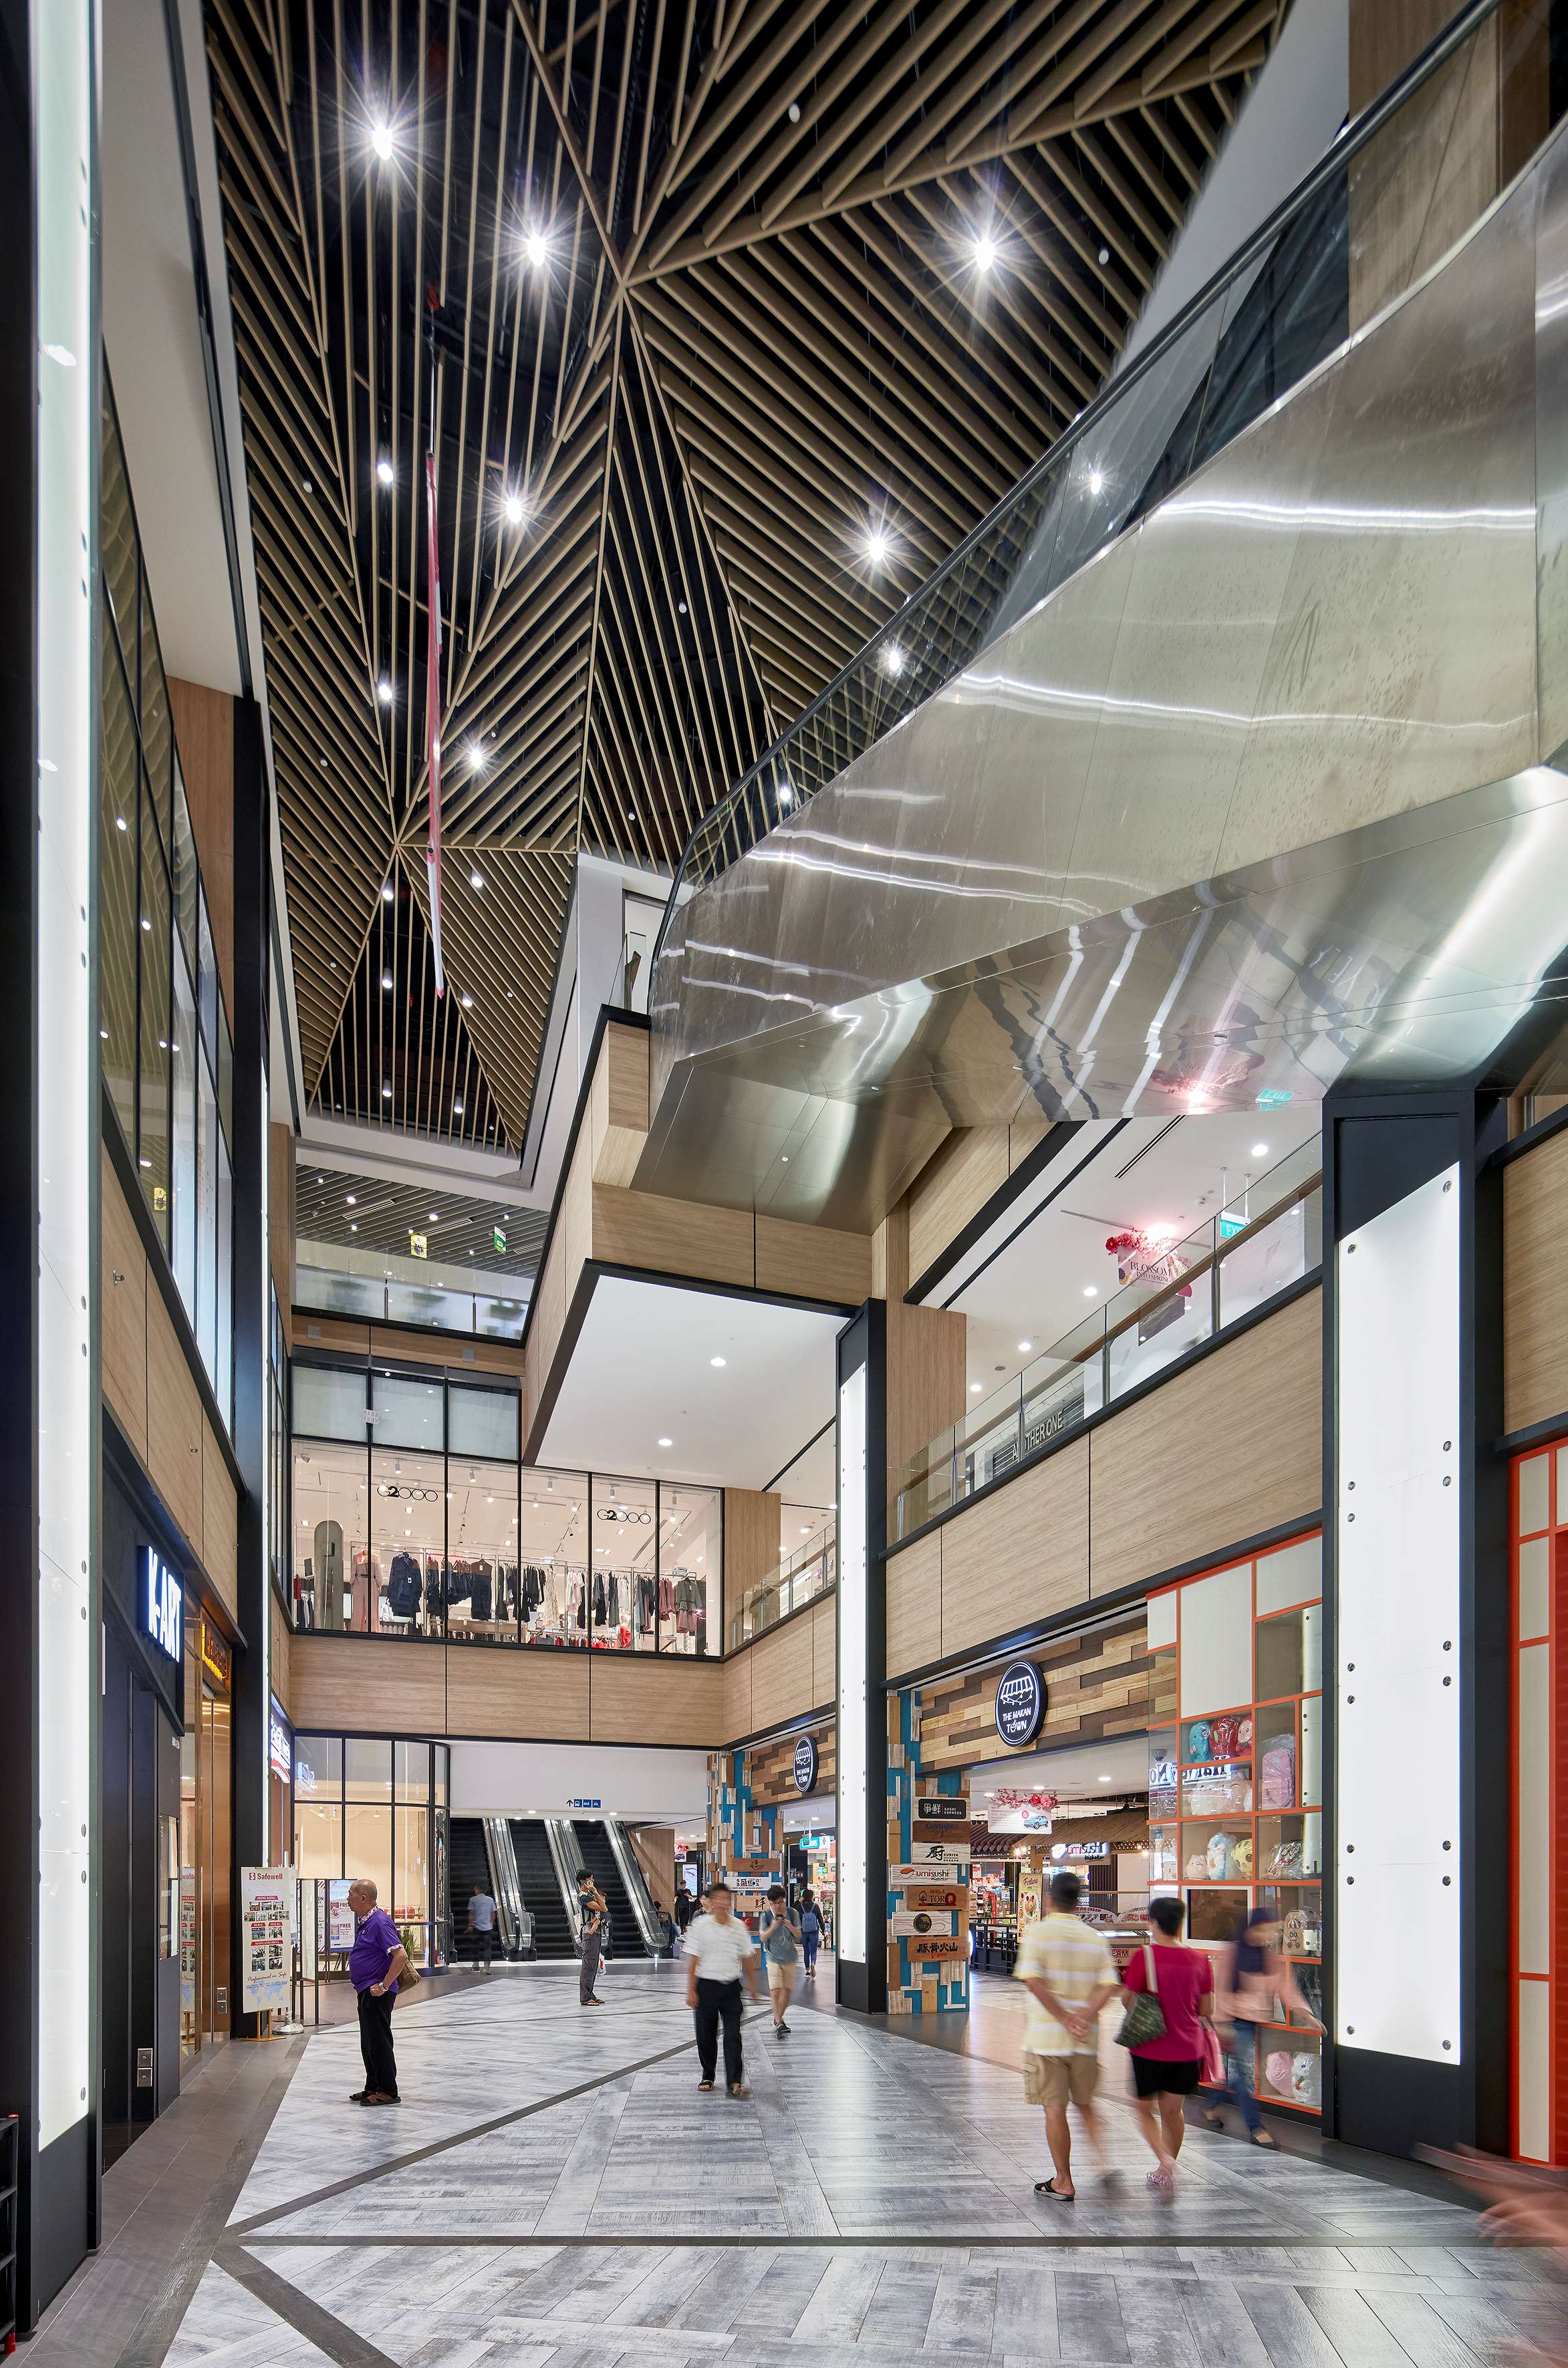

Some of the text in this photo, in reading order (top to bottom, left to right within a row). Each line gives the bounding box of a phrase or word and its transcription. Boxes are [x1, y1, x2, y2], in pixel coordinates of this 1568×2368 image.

[1130, 1261, 1170, 1277] BLOSSOM
[1012, 1411, 1063, 1461] ATHER ONE
[377, 1486, 438, 1502] G2000
[597, 1508, 652, 1525] G2000
[1002, 1707, 1031, 1722] THE MAKAN
[1006, 1719, 1027, 1734] TOWN
[916, 1869, 949, 1877] umisushi
